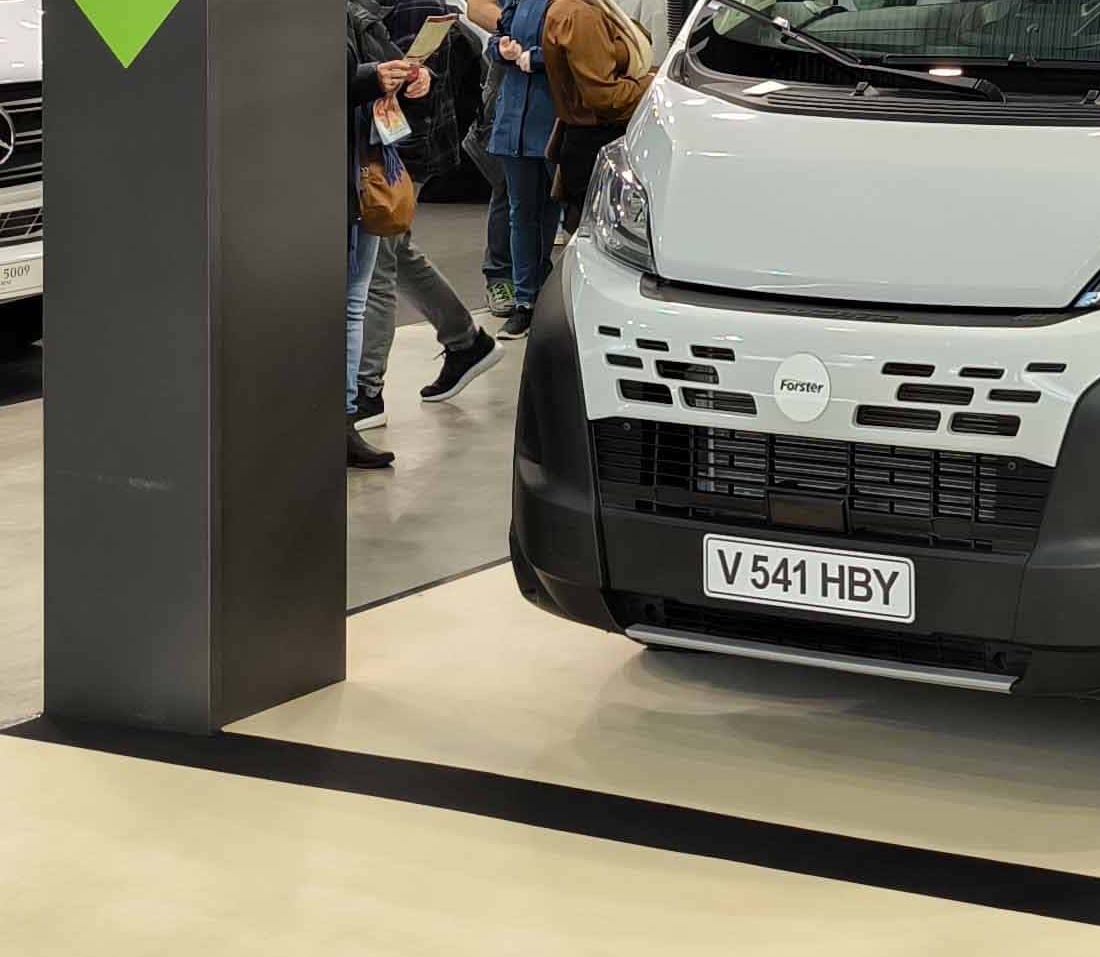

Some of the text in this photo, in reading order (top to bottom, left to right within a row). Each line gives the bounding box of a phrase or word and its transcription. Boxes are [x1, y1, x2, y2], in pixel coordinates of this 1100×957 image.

[3, 265, 31, 279] 5009
[780, 379, 825, 394] Forster
[717, 548, 901, 607] V 541 HBY
